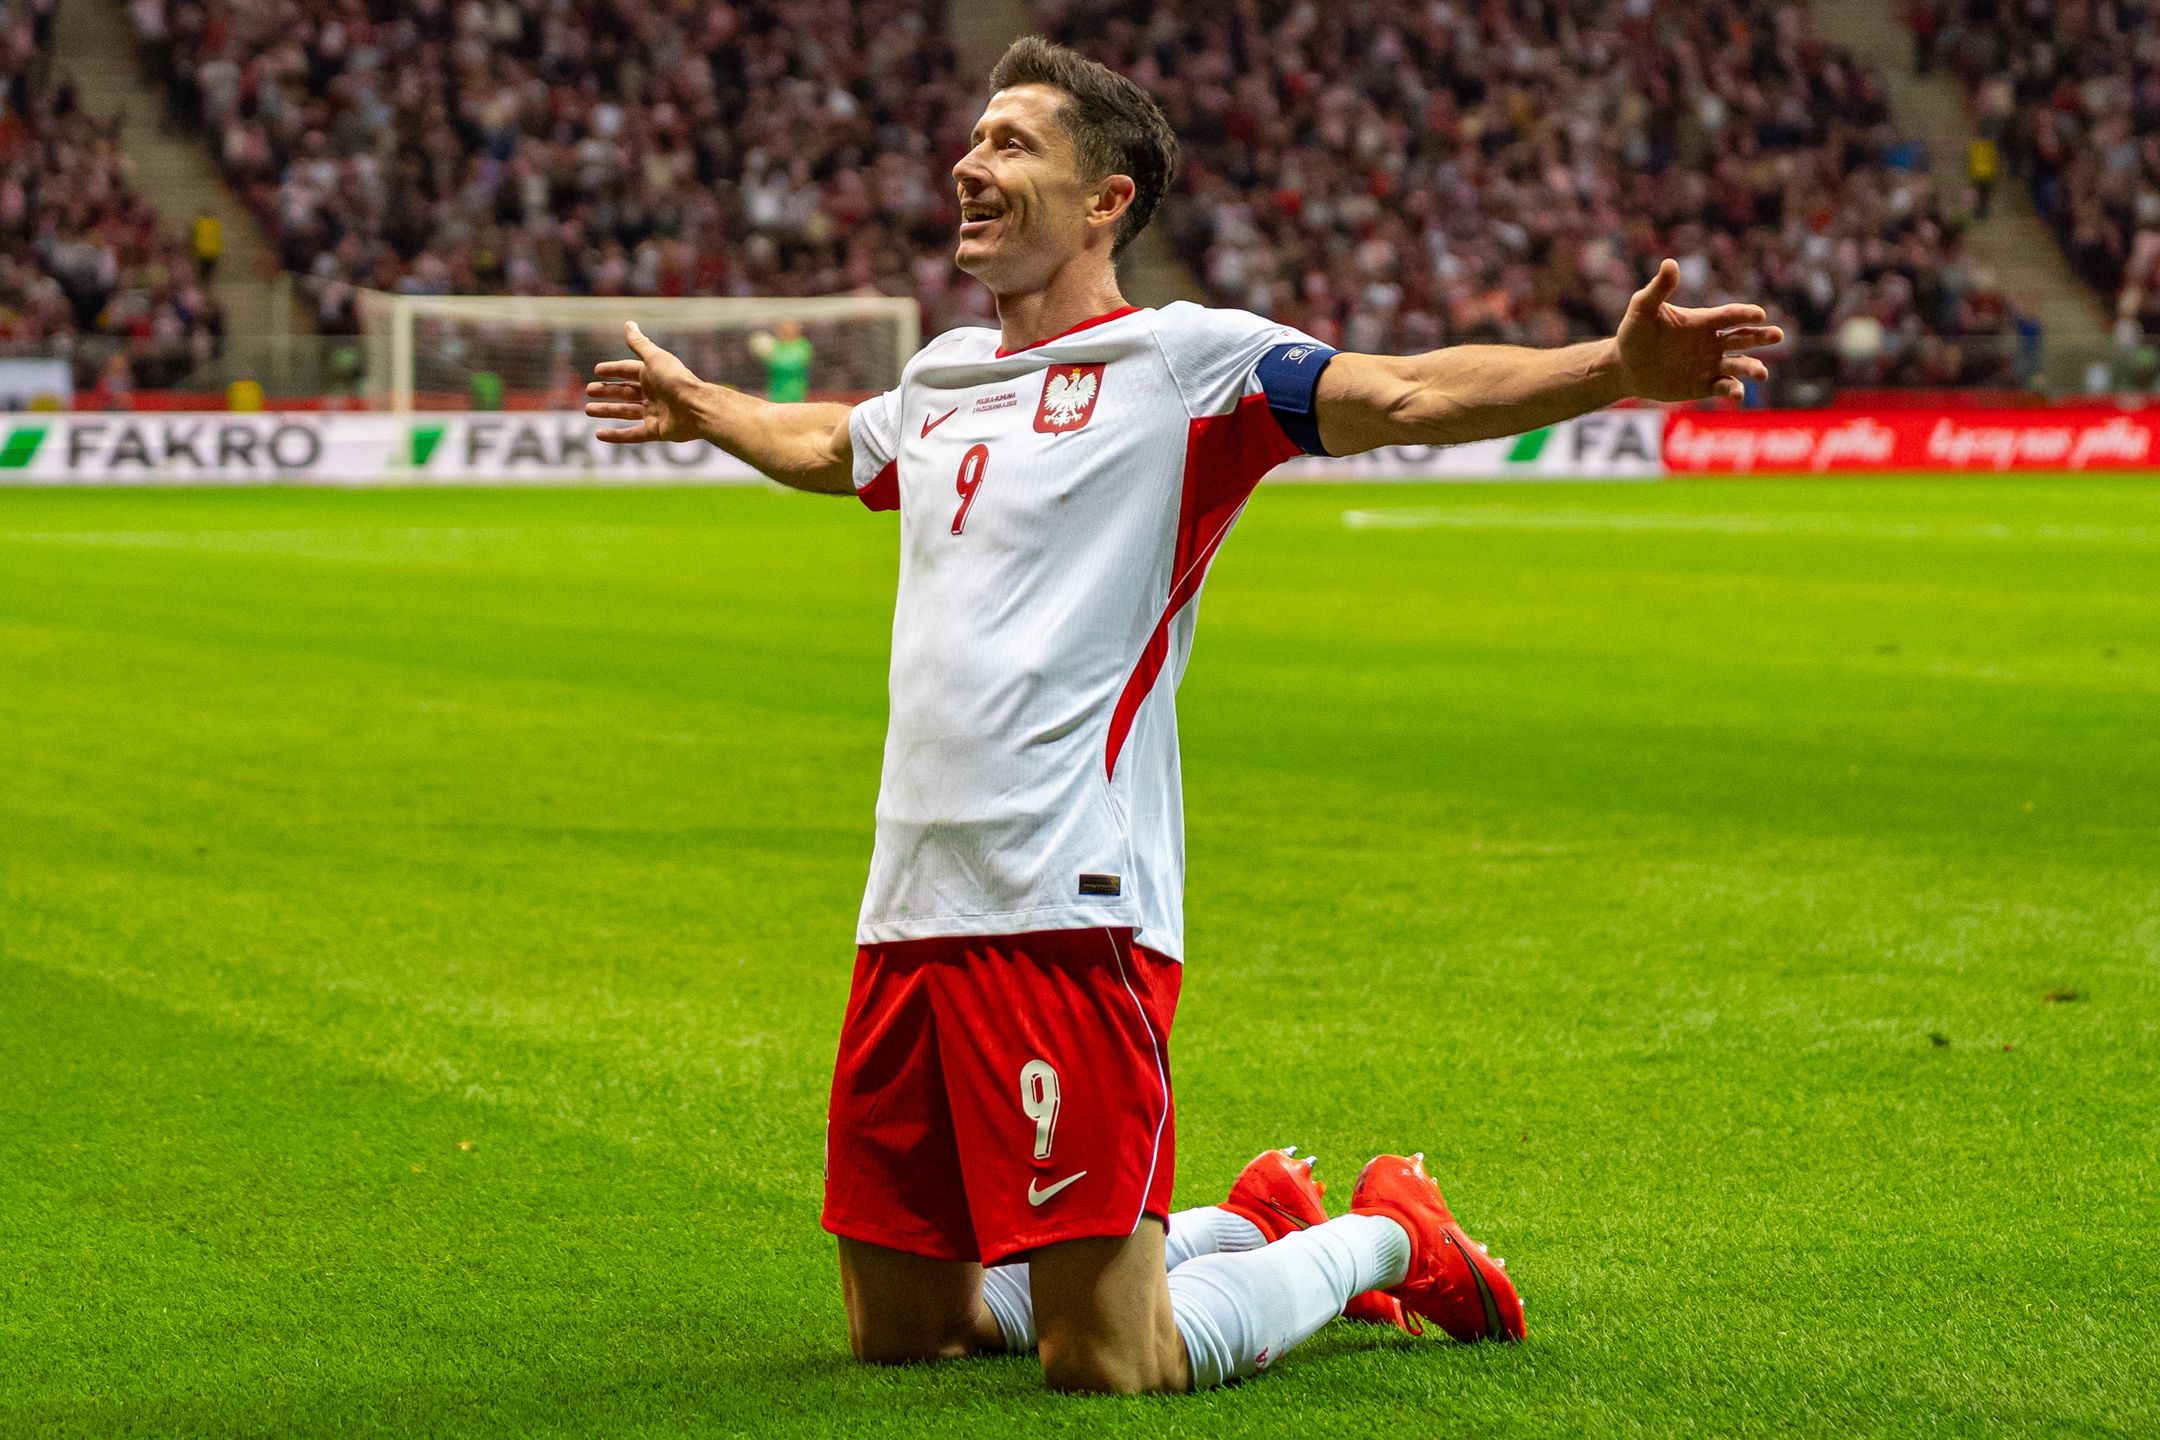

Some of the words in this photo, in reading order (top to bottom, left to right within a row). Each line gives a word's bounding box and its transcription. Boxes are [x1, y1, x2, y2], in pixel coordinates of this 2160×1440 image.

[68, 423, 322, 468] FAKRO
[951, 443, 990, 535] 9
[1020, 1058, 1060, 1160] 9
